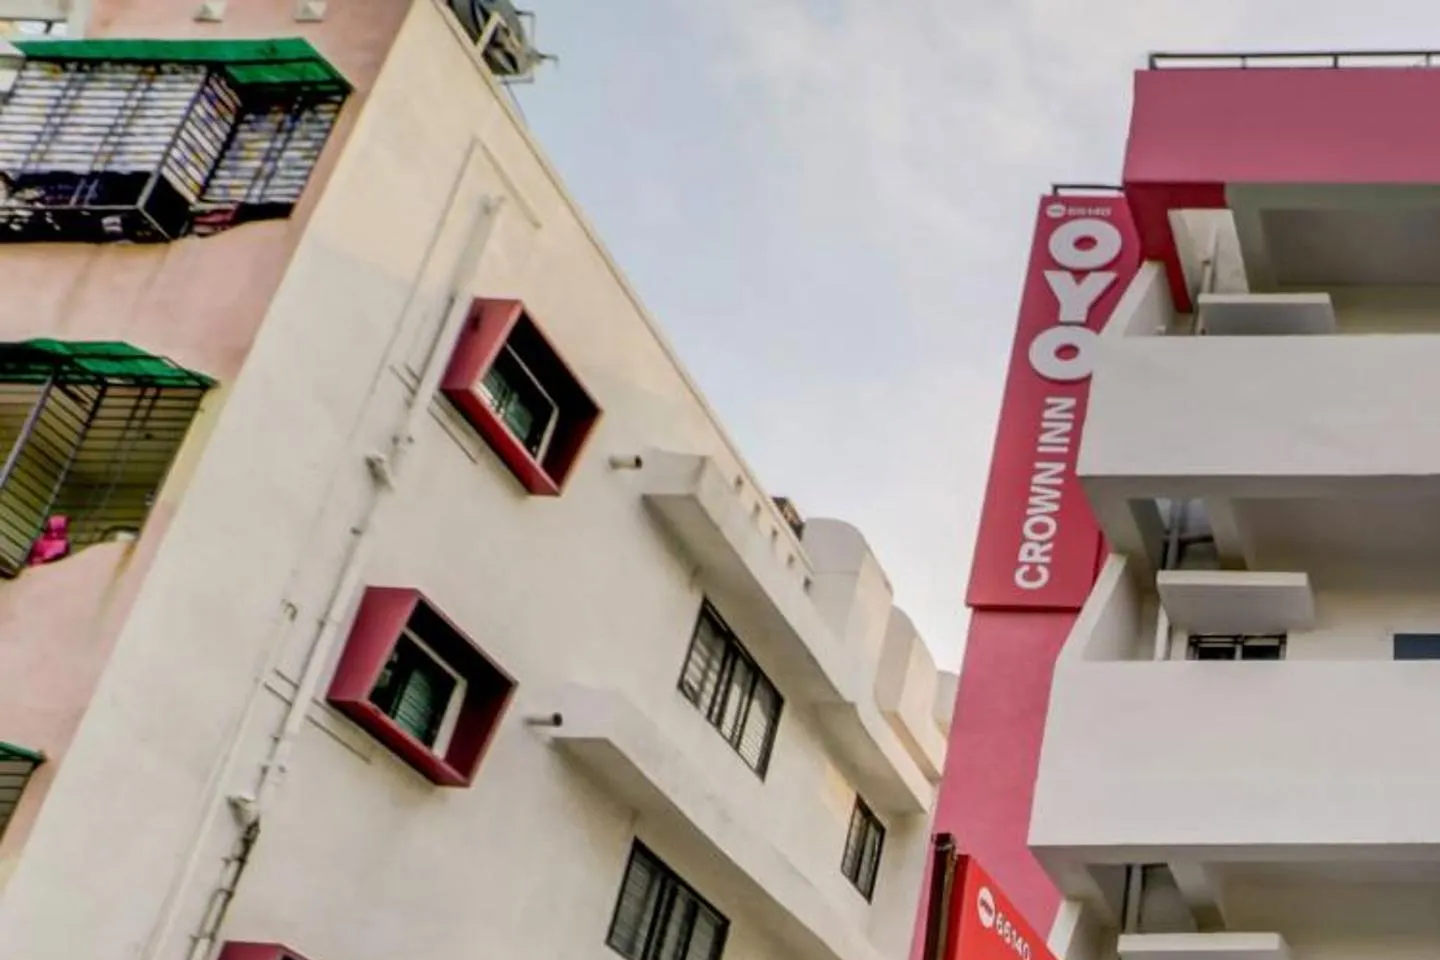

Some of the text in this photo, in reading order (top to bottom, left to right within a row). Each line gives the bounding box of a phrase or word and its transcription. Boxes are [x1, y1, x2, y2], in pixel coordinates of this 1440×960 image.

[1028, 218, 1123, 381] OYO
[1013, 396, 1077, 590] CROWN INN
